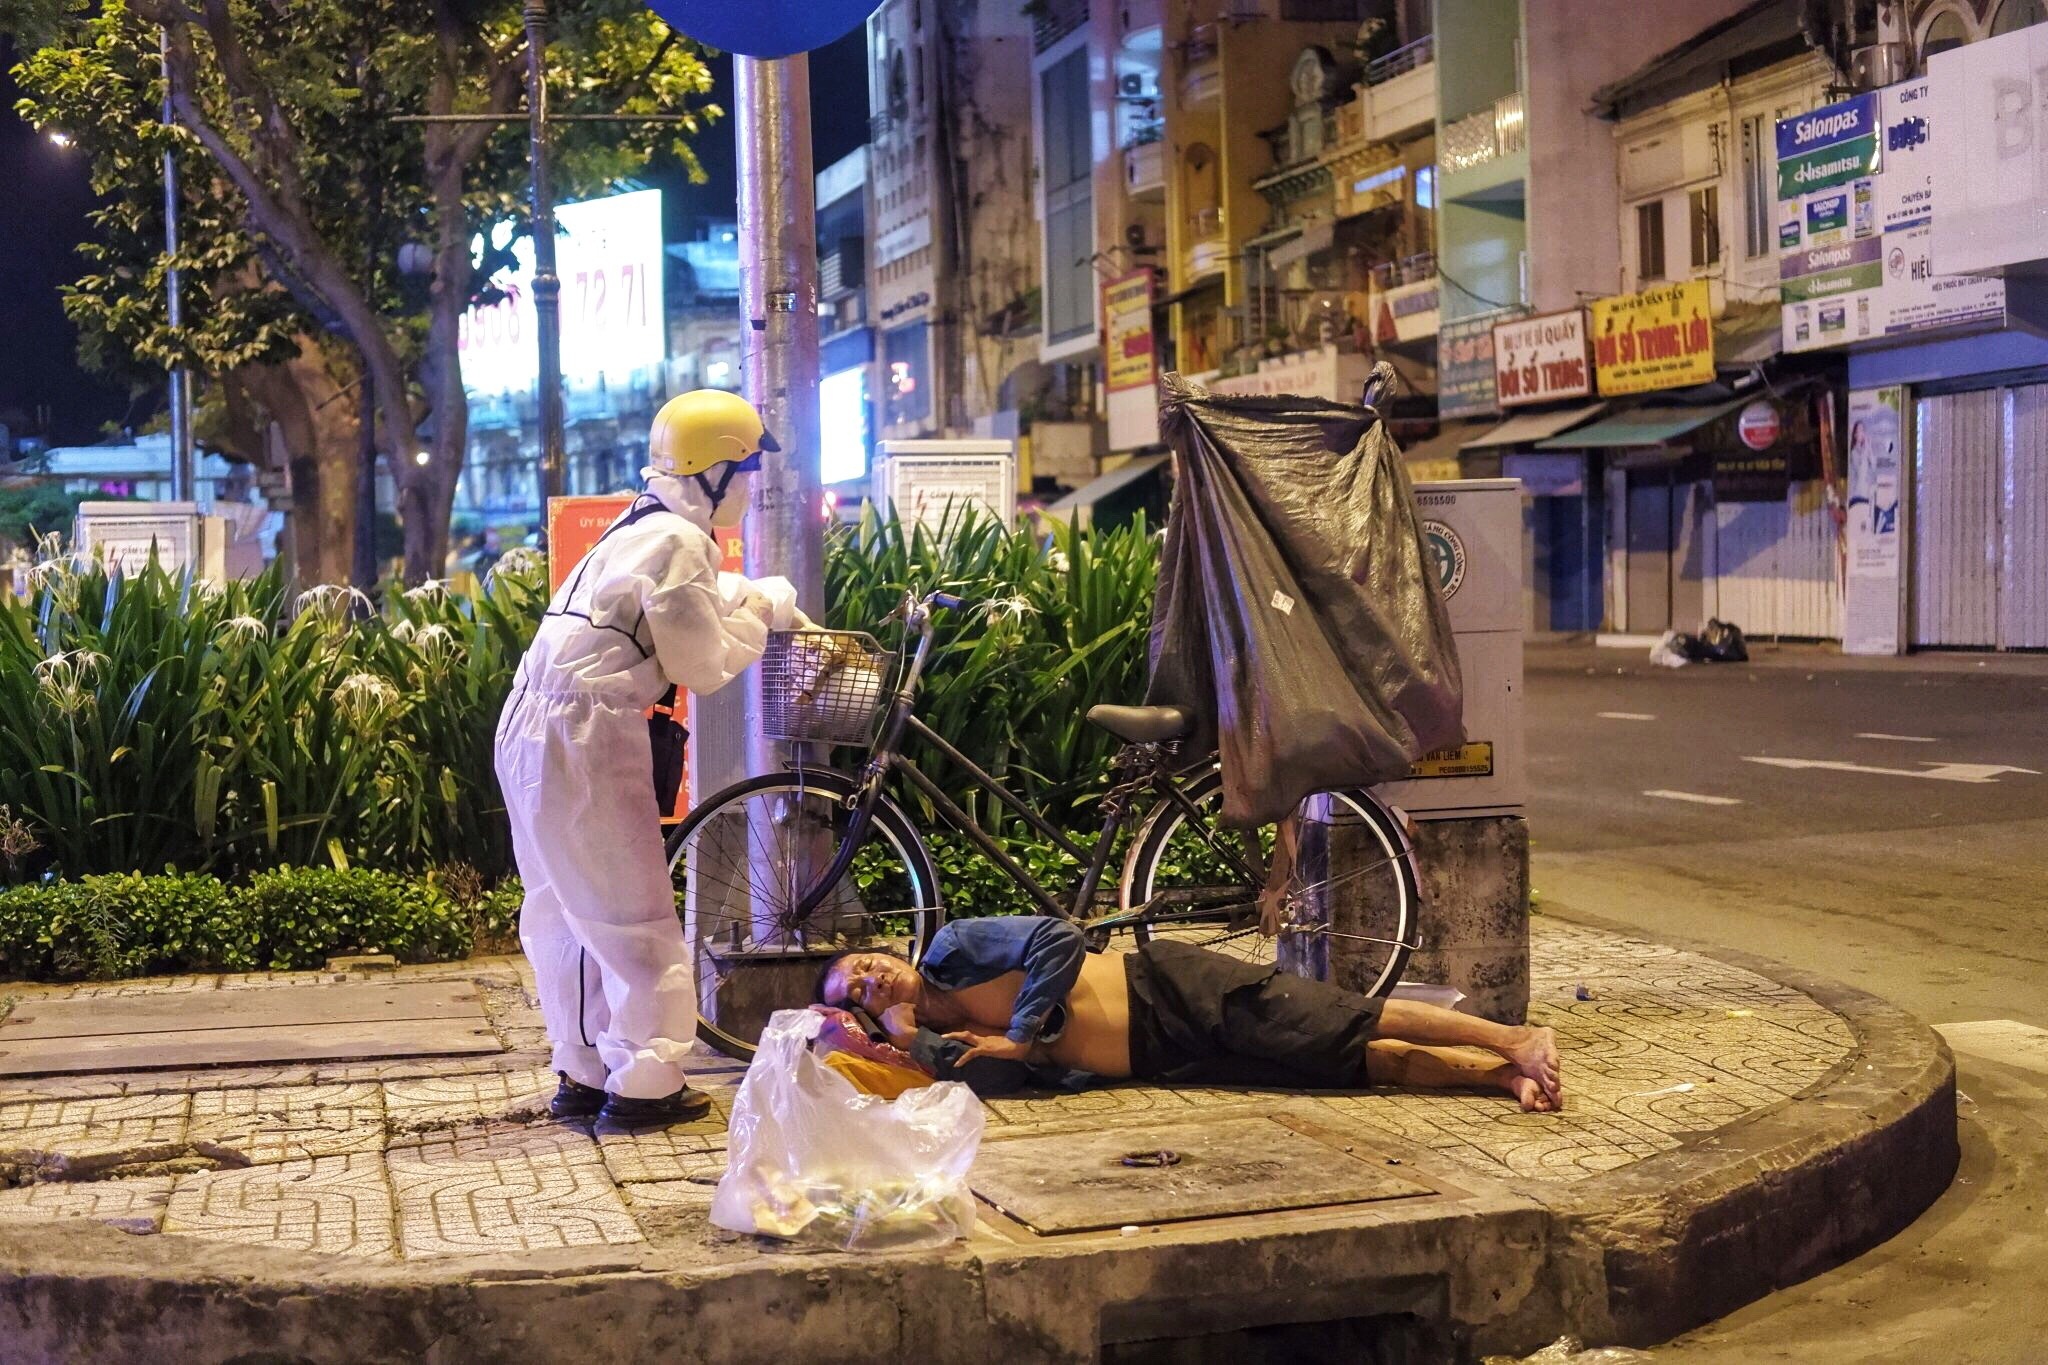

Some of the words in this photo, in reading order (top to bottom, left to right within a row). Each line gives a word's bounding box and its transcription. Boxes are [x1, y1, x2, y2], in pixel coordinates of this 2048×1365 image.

[1920, 86, 1928, 97] TY
[1795, 109, 1858, 144] Salonpas
[1794, 156, 1860, 183] Hisamitsu
[1808, 247, 1851, 270] Salonpas
[1808, 277, 1852, 295] Hisamitsu
[597, 518, 615, 528] BA
